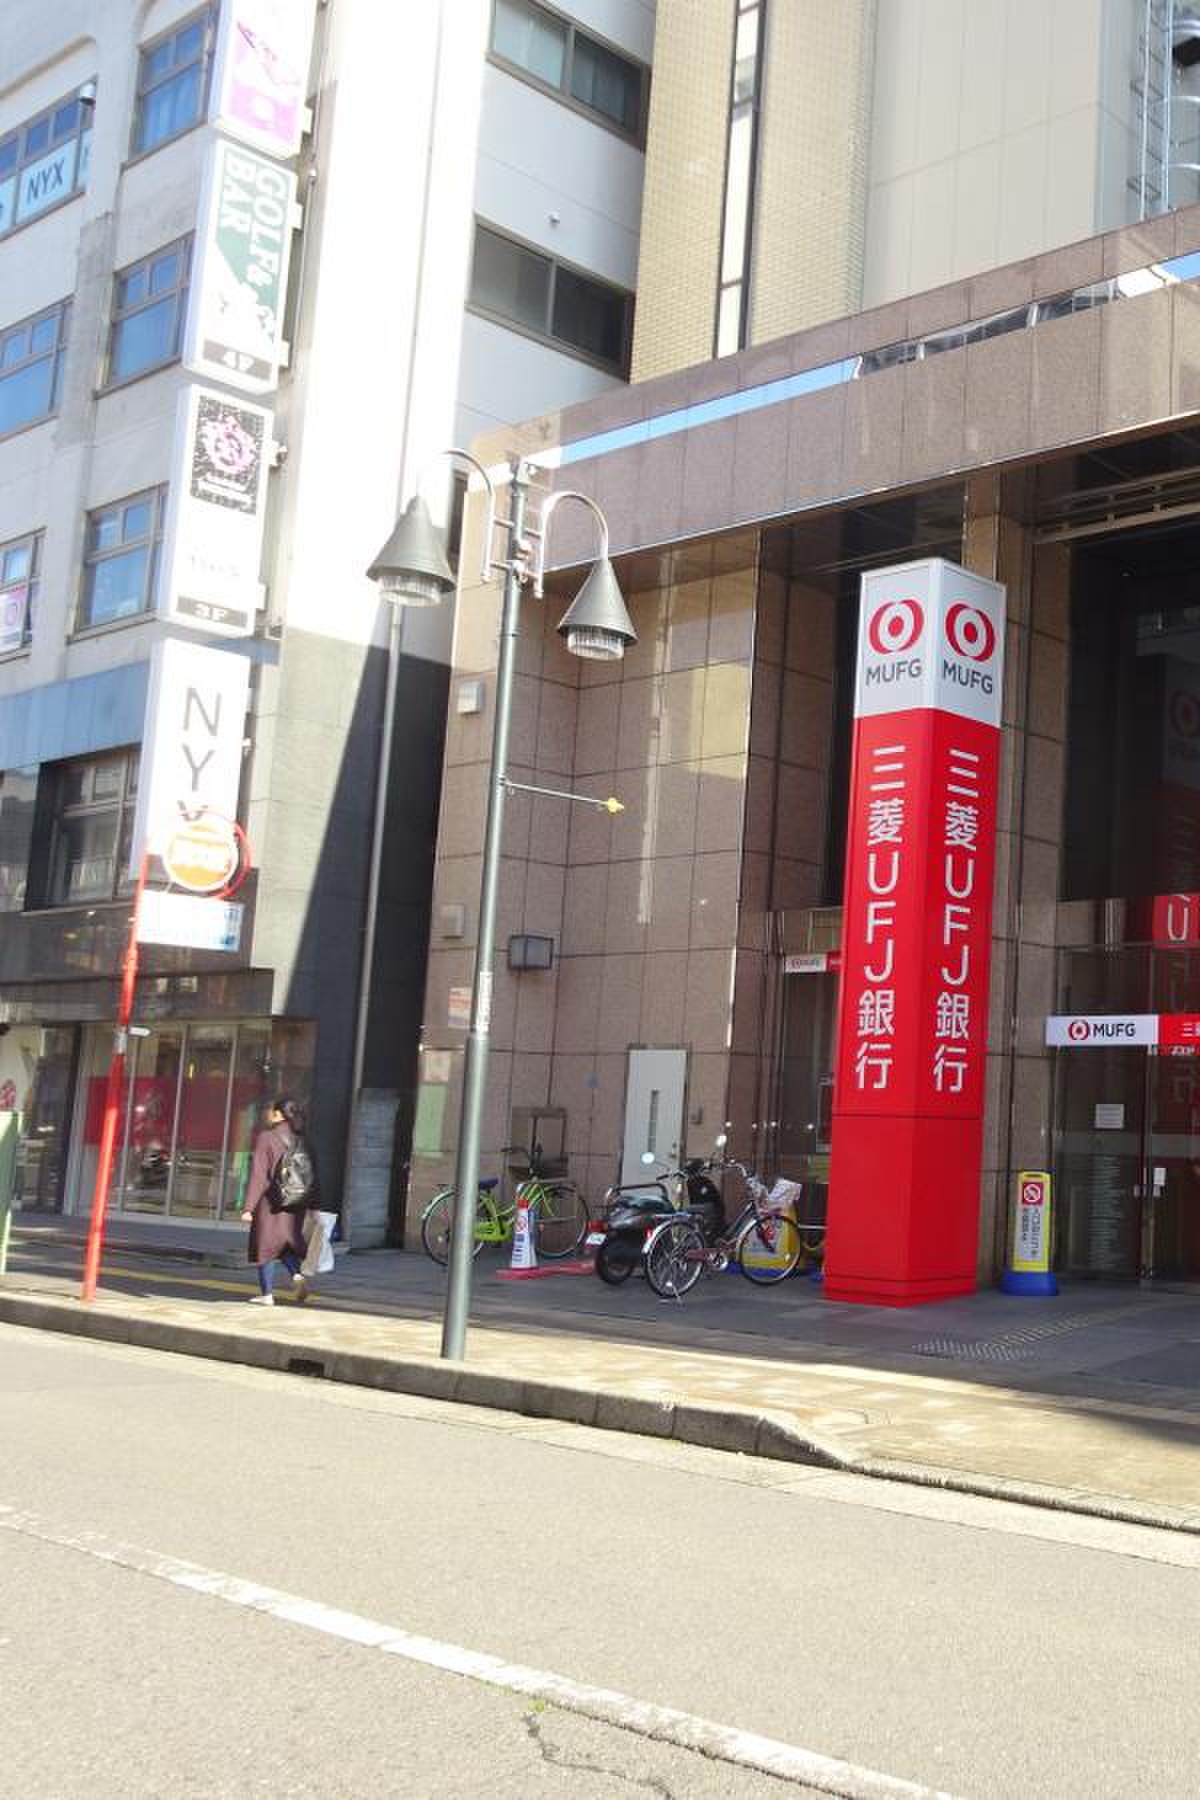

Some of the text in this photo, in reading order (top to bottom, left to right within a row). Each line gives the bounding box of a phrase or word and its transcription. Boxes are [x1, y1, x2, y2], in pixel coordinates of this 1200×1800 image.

[27, 157, 65, 206] NYX
[865, 658, 923, 690] MUFG
[942, 659, 994, 695] MUFG
[855, 744, 907, 1091] 三菱UFJ銀行
[934, 748, 980, 1095] 三菱UFJ銀行
[1092, 1022, 1136, 1039] MUFG
